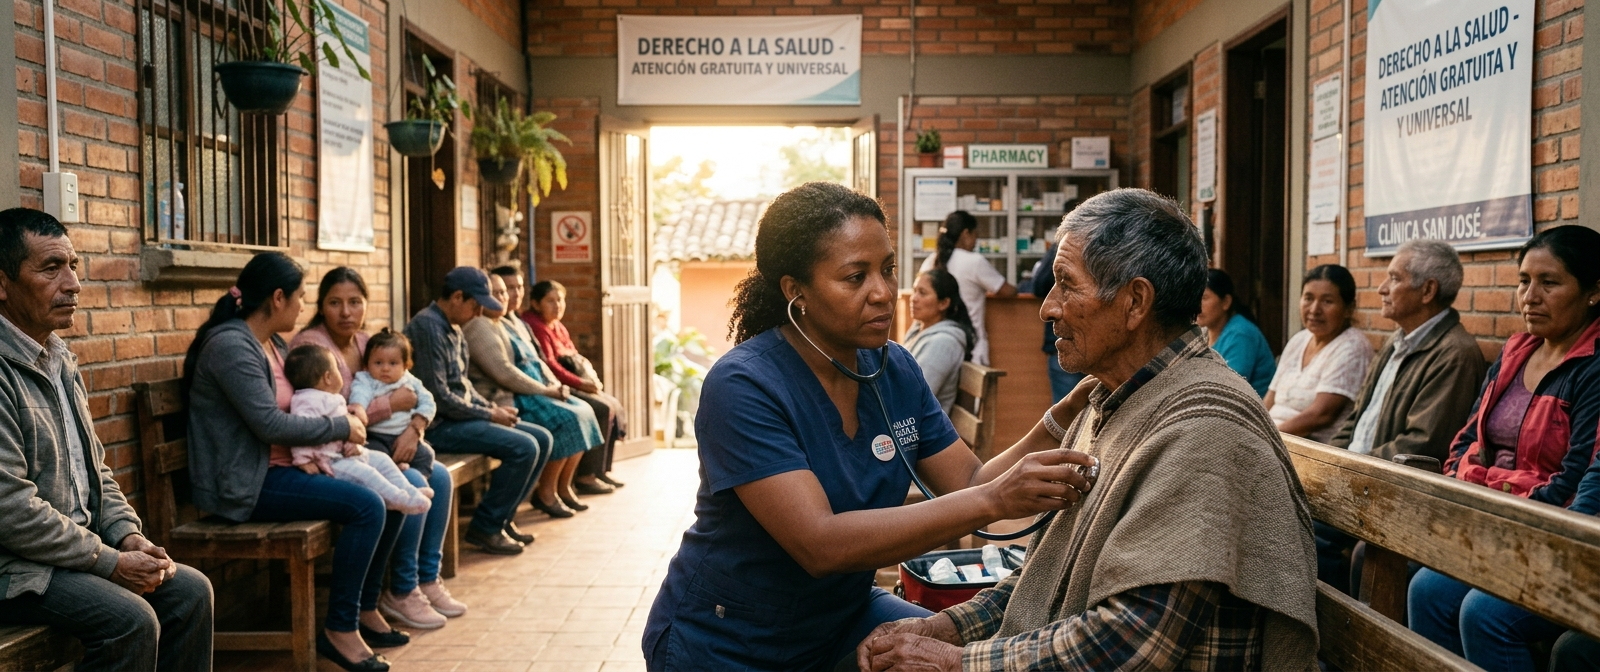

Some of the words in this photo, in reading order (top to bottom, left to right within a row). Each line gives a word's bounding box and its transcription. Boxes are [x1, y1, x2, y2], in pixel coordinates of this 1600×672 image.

[637, 37, 725, 56] DERECHO
[729, 37, 742, 56] A
[748, 37, 770, 56] LA
[774, 37, 834, 56] SALUD
[1378, 38, 1431, 80] DERECHO
[1434, 34, 1442, 59] A
[1446, 26, 1461, 55] LA
[1464, 5, 1509, 48] SALUD
[631, 59, 696, 75] ATENCIÓN
[700, 62, 763, 75] GRATUITA
[766, 62, 773, 75] Y
[777, 62, 849, 75] UNIVERSAL
[1380, 68, 1437, 112] ATENCIÓN
[1440, 47, 1504, 92] GRATUITA
[1507, 41, 1518, 70] Y
[1397, 116, 1404, 139] Y
[1406, 96, 1472, 137] UNIVERSAL
[971, 149, 1045, 163] PHARMACY
[1422, 216, 1447, 240] SAN
